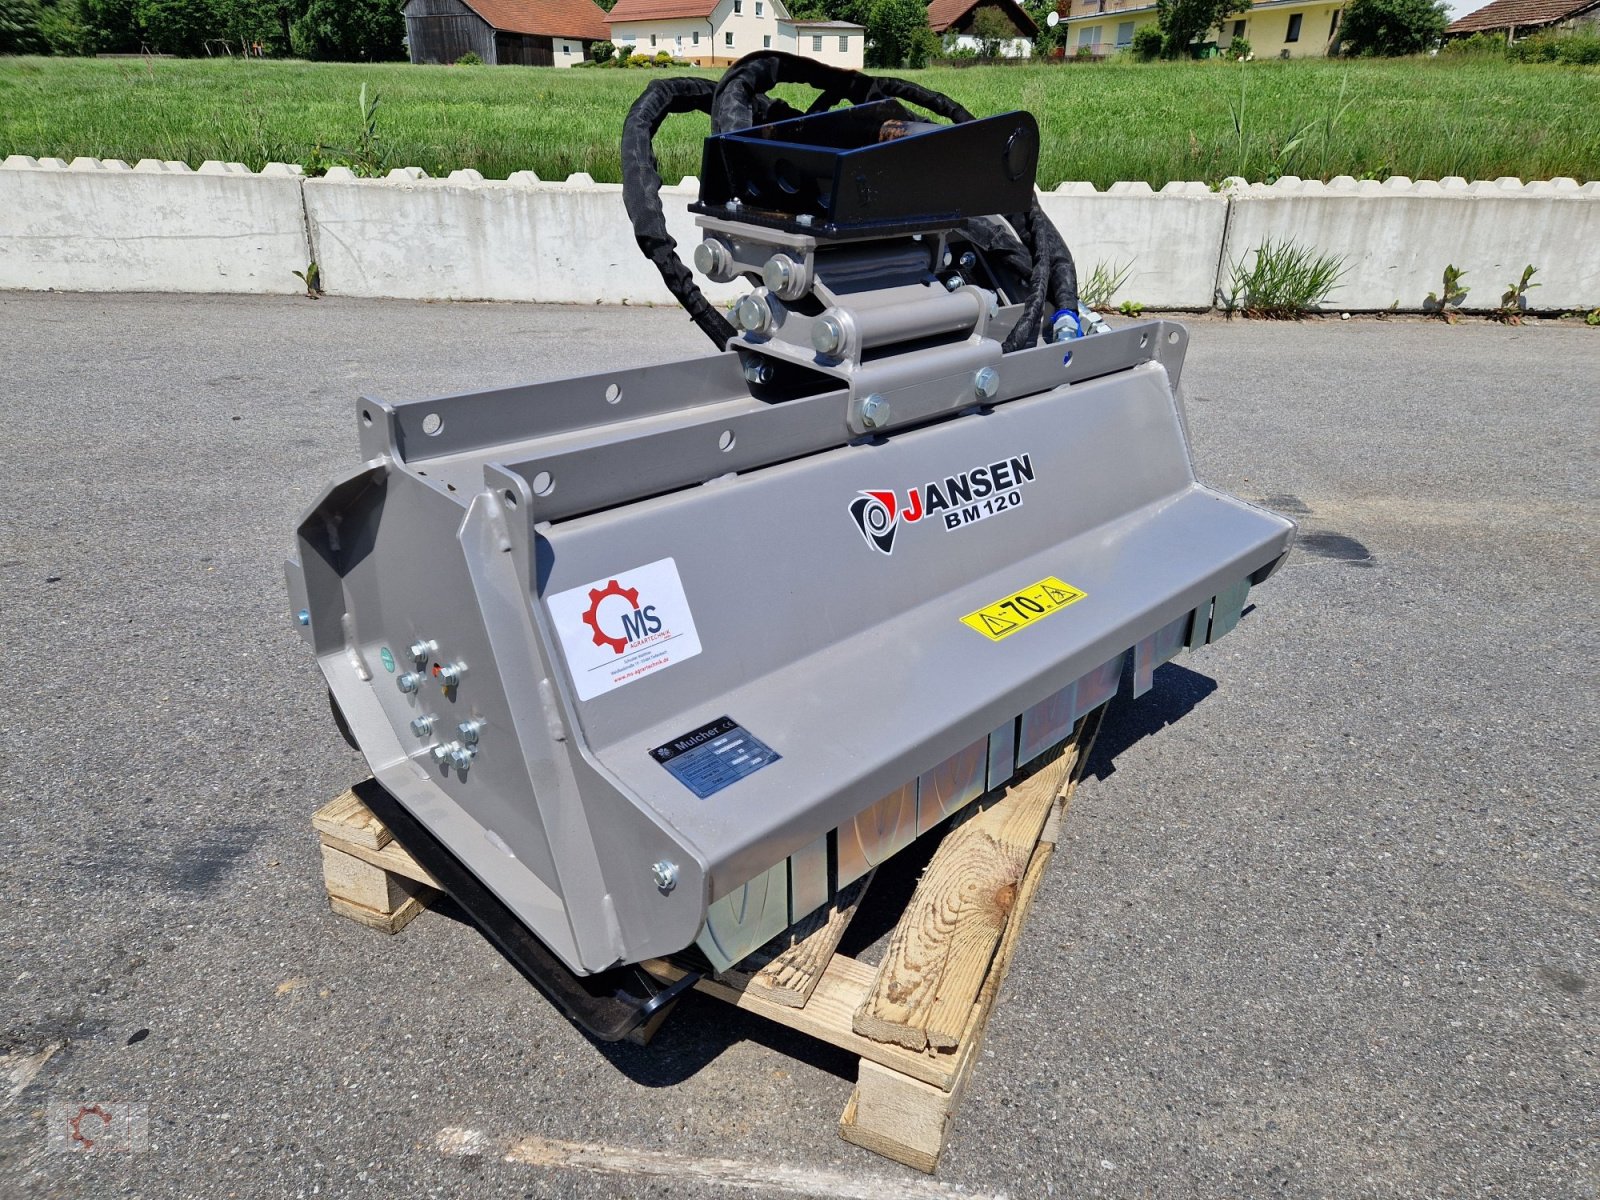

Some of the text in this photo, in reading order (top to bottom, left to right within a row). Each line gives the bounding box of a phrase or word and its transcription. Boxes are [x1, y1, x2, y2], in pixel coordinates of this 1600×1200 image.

[902, 454, 1035, 522] JANSEN
[944, 491, 1021, 530] BM 120
[621, 604, 662, 643] MS
[999, 596, 1045, 620] 70
[630, 629, 671, 649] AGRARTECHNIK
[674, 727, 720, 751] Mulcher
